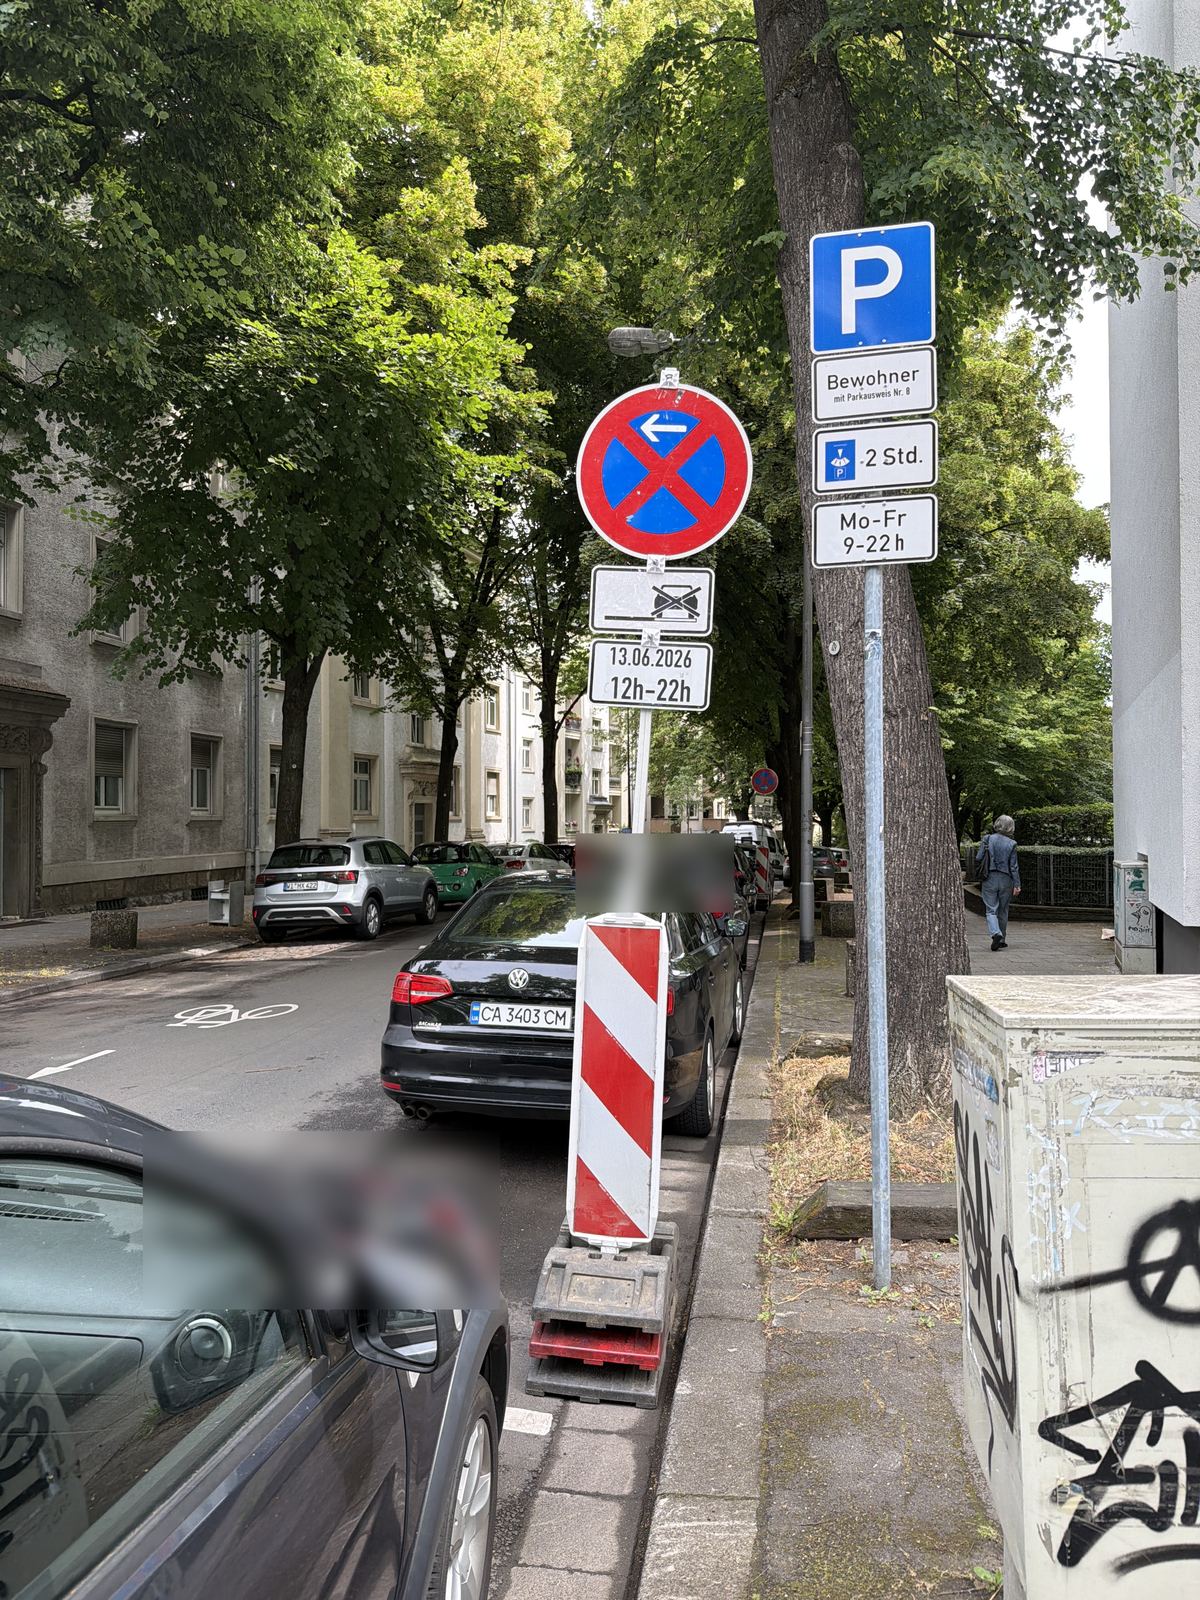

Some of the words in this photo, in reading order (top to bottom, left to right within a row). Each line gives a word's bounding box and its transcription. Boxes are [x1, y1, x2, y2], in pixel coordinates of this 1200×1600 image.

[841, 245, 903, 335] P
[827, 369, 920, 391] Bewohner
[833, 394, 845, 403] mit
[847, 389, 892, 402] Parkausweis
[893, 388, 904, 397] Nr.
[865, 448, 877, 467] 2
[883, 445, 923, 466] Std.
[840, 509, 907, 531] Mo-Fr
[843, 534, 890, 555] 9-22
[609, 646, 692, 668] 13.06.2026
[610, 676, 691, 703] 12h-22h
[481, 1006, 502, 1023] CA
[506, 1007, 541, 1024] 3403
[543, 1009, 567, 1026] CM
